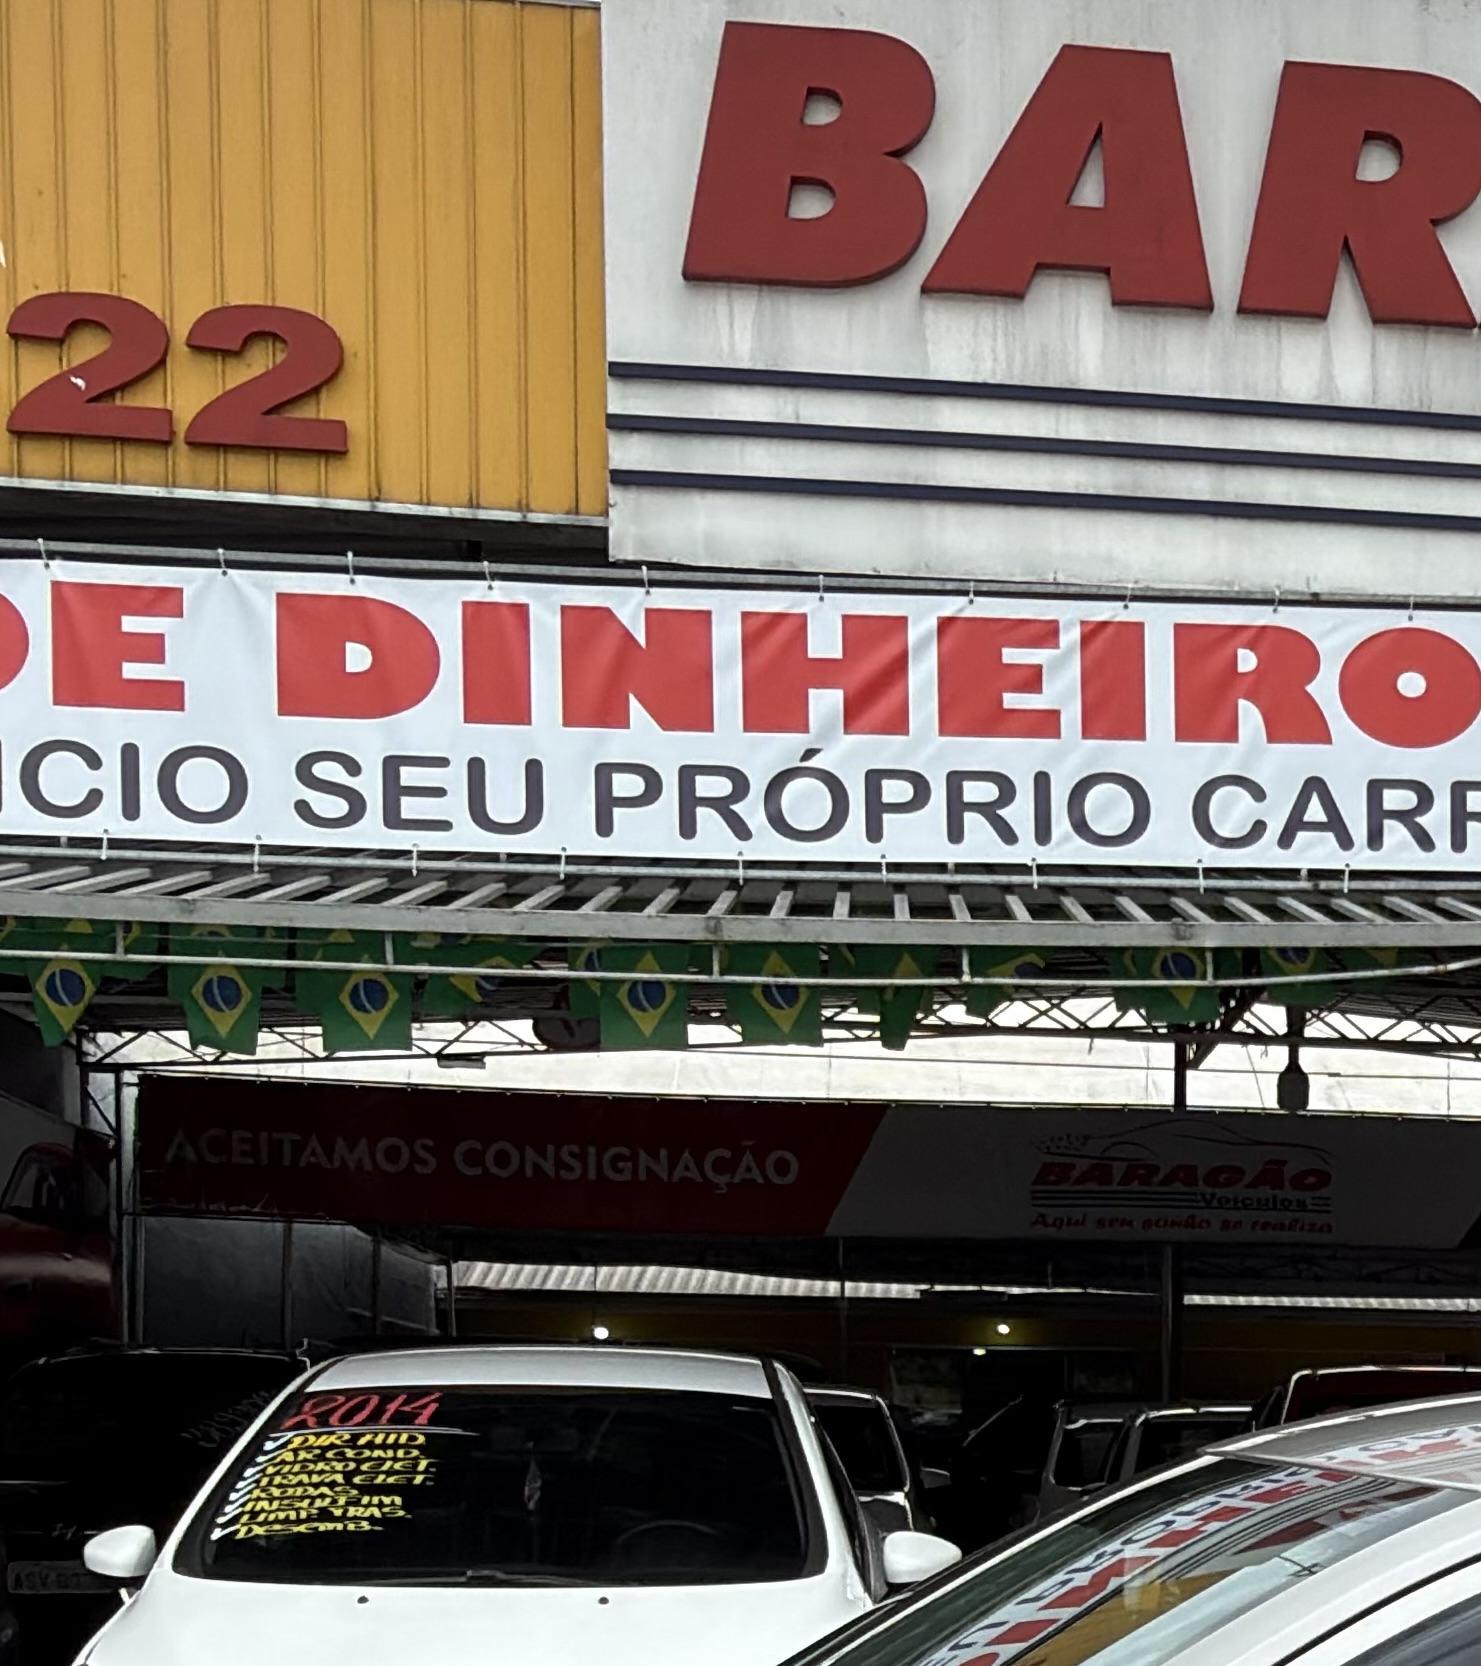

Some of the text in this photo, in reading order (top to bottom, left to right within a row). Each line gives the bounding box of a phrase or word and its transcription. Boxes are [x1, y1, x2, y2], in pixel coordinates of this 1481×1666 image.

[293, 750, 544, 836] SEU
[594, 747, 1152, 848] PRÓPRIO
[164, 1125, 801, 1194] ACEITAMOS CONSIGNAÇÃO
[1030, 1158, 1332, 1192] BARAGÃO
[280, 1391, 443, 1430] 2014
[286, 1432, 426, 1450] DIR HID
[264, 1460, 356, 1475] VIDRO
[275, 1448, 321, 1464] AR
[259, 1473, 345, 1487] TRAVA
